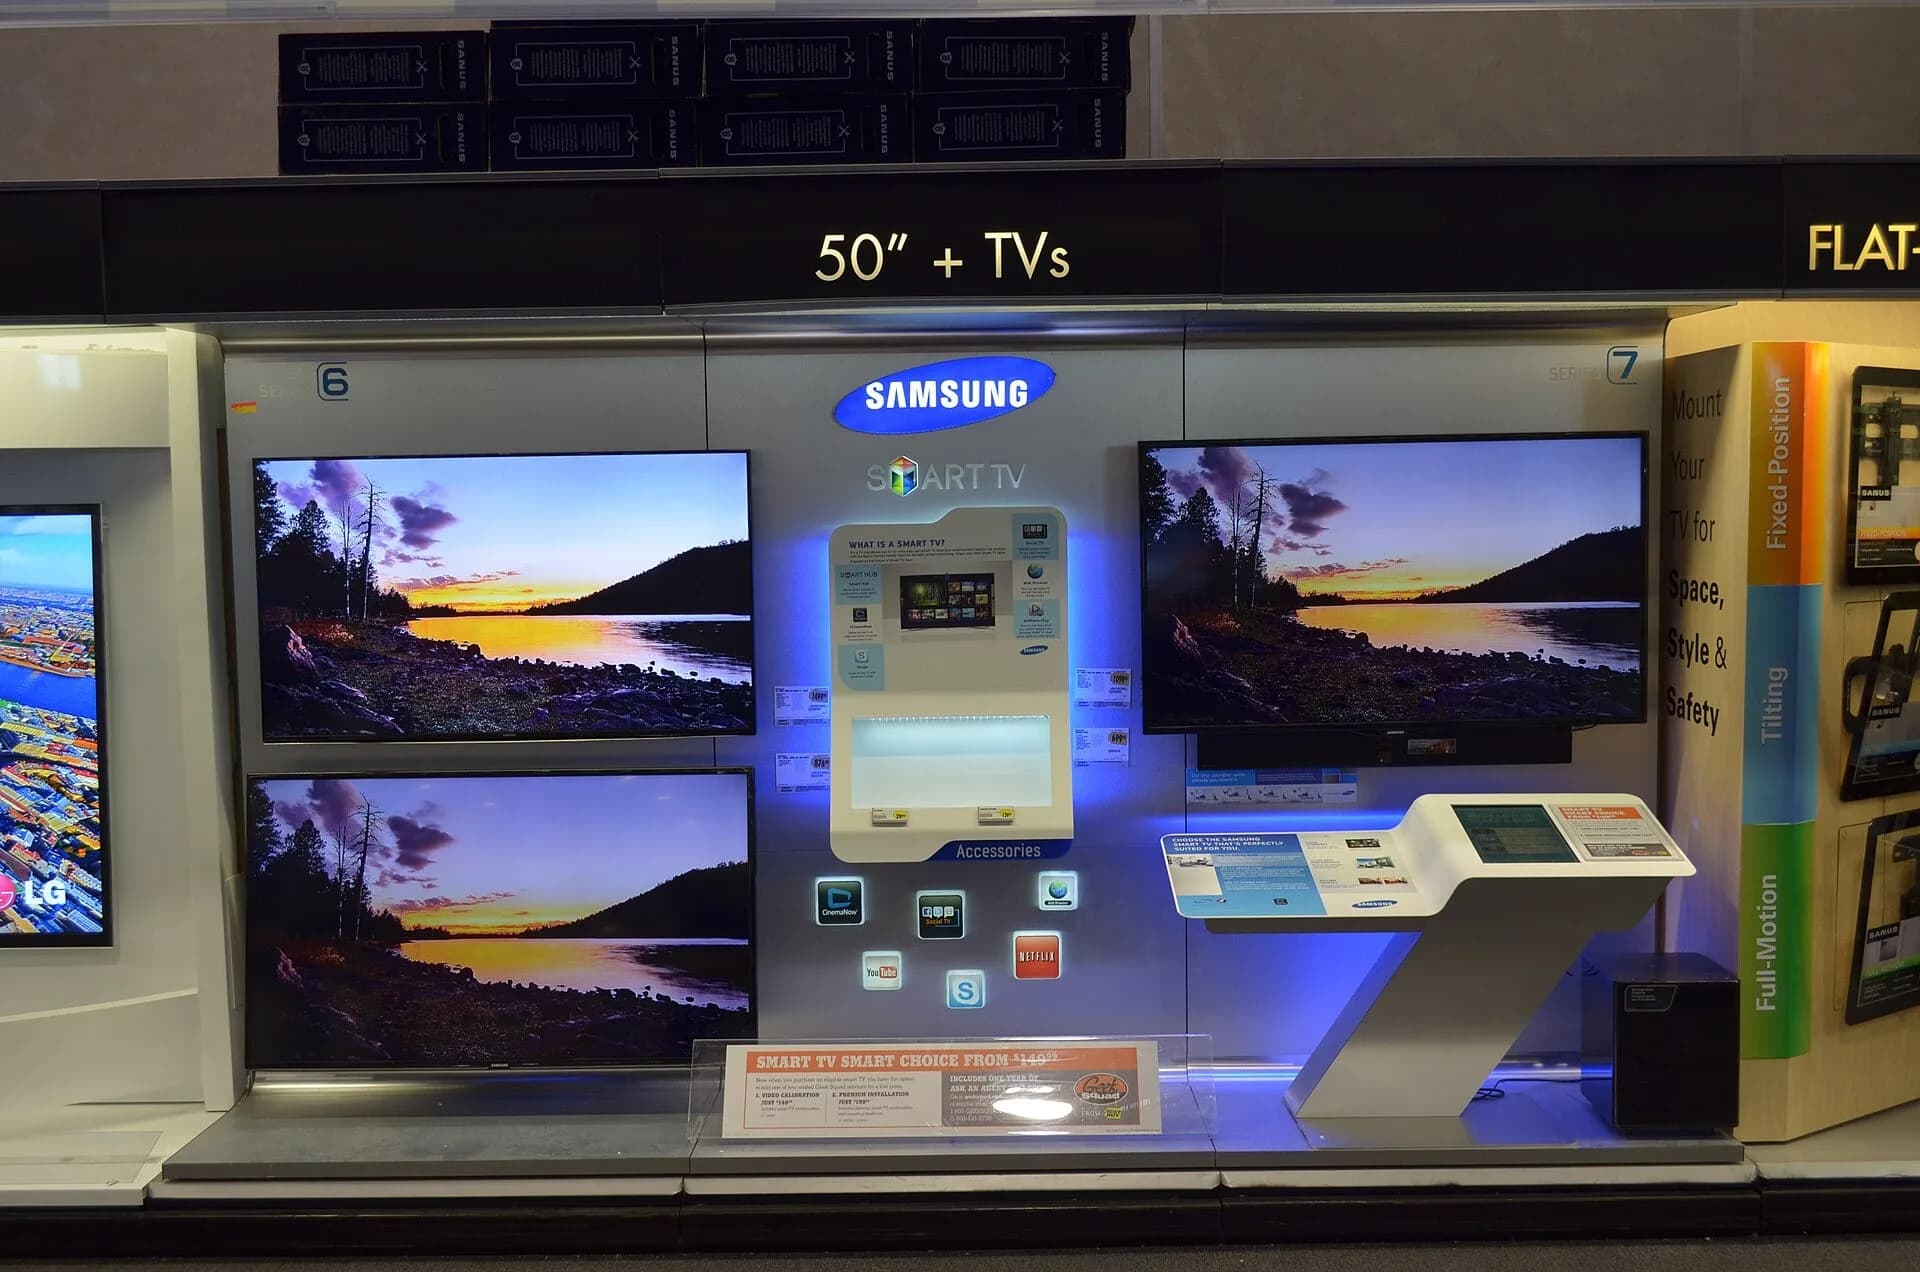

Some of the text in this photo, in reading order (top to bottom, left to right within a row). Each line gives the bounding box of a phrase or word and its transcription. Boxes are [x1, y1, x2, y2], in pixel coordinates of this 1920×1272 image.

[457, 39, 466, 90] SANUS
[671, 35, 680, 87] SANUS
[886, 30, 895, 82] SANUS
[1100, 31, 1109, 82] SANUS
[456, 111, 466, 164] SANUS
[668, 108, 677, 161] SANUS
[880, 103, 888, 155] SANUS
[1093, 97, 1102, 149] SANUS
[933, 247, 963, 279] +
[984, 231, 1070, 280] TVs
[1809, 223, 1920, 271] FLAT-
[322, 367, 349, 396] 6
[1612, 351, 1638, 379] 7
[865, 379, 1028, 410] SAMSUNG
[1671, 389, 1723, 421] Mount
[990, 463, 1027, 489] TV
[1670, 452, 1705, 480] Your
[1766, 376, 1791, 550] Fixed-Position
[1861, 489, 1890, 497] SANUS
[849, 541, 874, 549] WHAT
[897, 540, 926, 548] SMART
[930, 539, 946, 547] TV?
[1670, 510, 1715, 543] TV for
[1668, 568, 1724, 610] Space,
[1667, 628, 1728, 670] Style &
[1667, 686, 1720, 736] Safety
[1761, 666, 1788, 744] Tilting
[956, 843, 1041, 859] Accessories
[24, 879, 67, 905] LG
[822, 908, 858, 916] CinemaNow
[1755, 873, 1778, 1011] Full-Motion
[1869, 926, 1898, 939] SANUS
[1019, 951, 1056, 962] NETFLIX
[958, 982, 974, 1000] S
[756, 1055, 811, 1069] SMART
[816, 1055, 837, 1068] TV
[841, 1054, 895, 1068] SMART
[900, 1054, 959, 1067] CHOICE
[963, 1054, 1008, 1067] FROM
